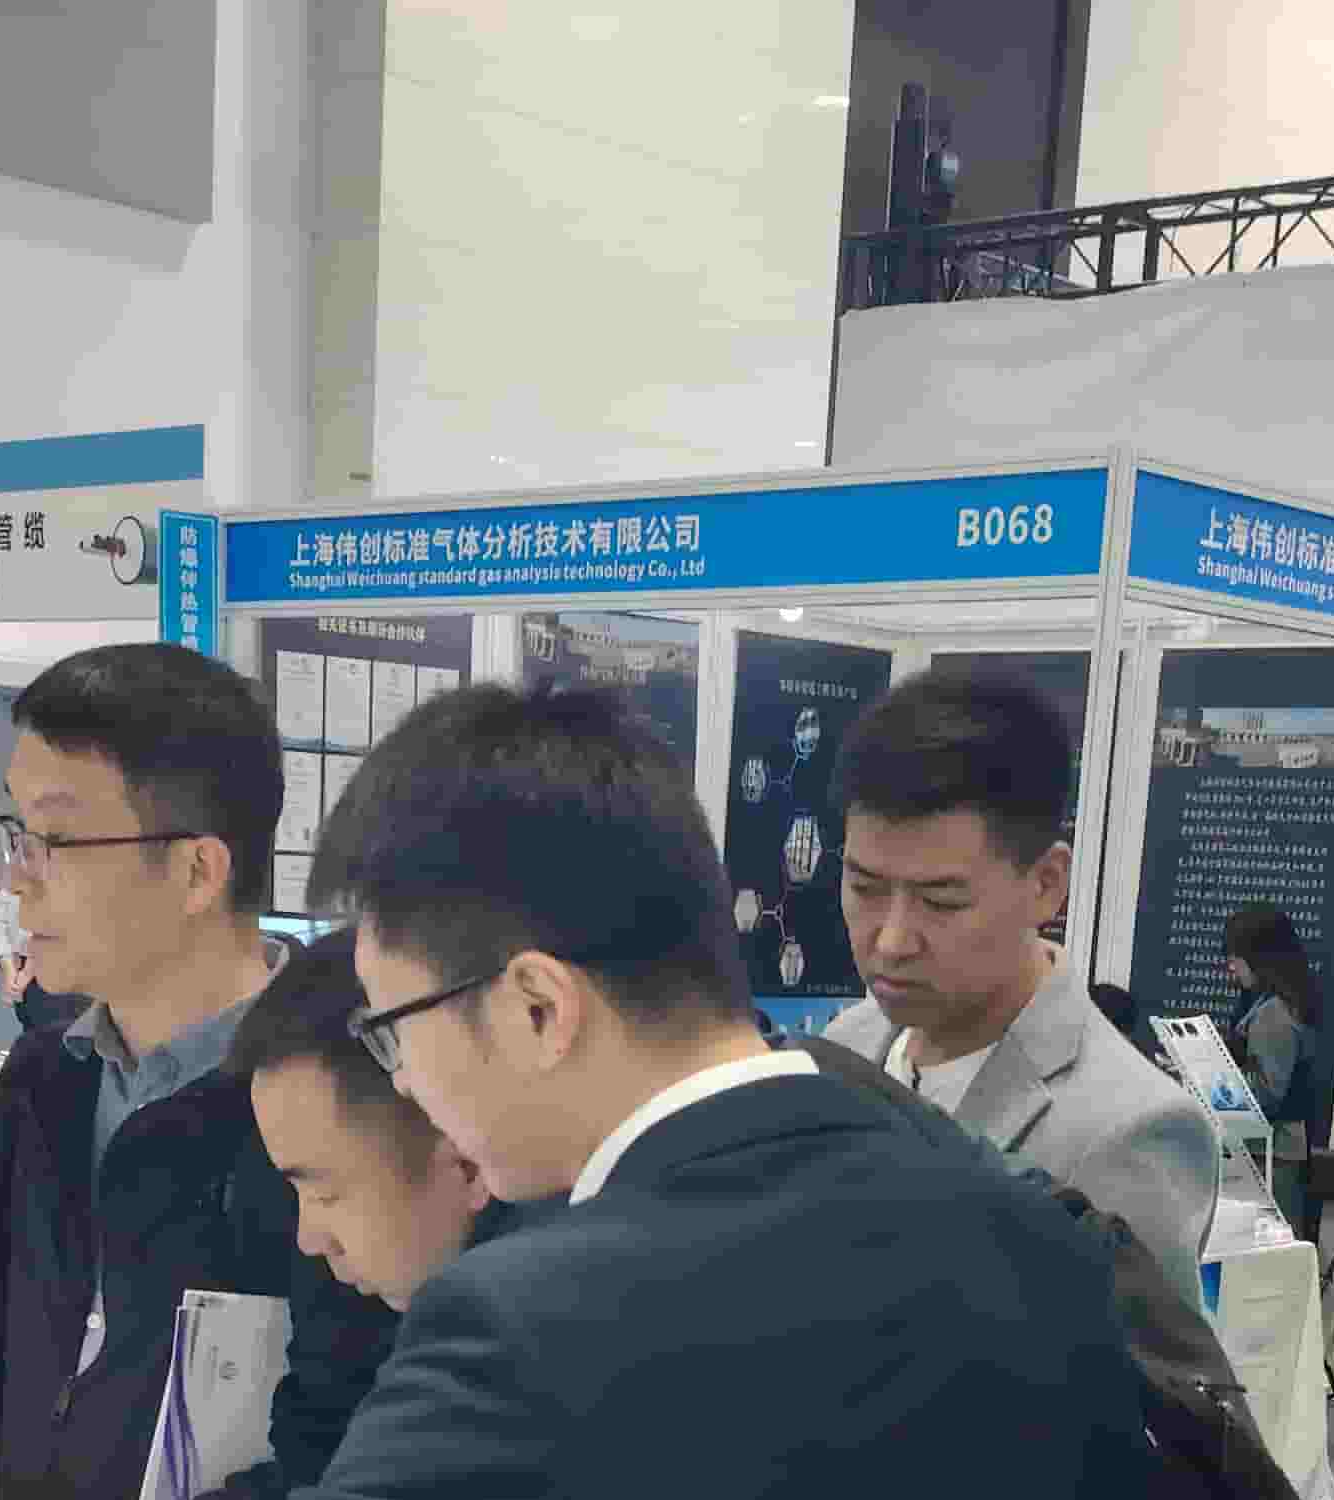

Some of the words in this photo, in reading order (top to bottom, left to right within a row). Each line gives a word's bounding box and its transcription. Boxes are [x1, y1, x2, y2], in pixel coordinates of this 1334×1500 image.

[289, 513, 700, 567] 上海伟创标准气体分析技术有限公司
[957, 504, 1053, 547] B068
[418, 568, 476, 585] standard
[563, 559, 644, 583] technology
